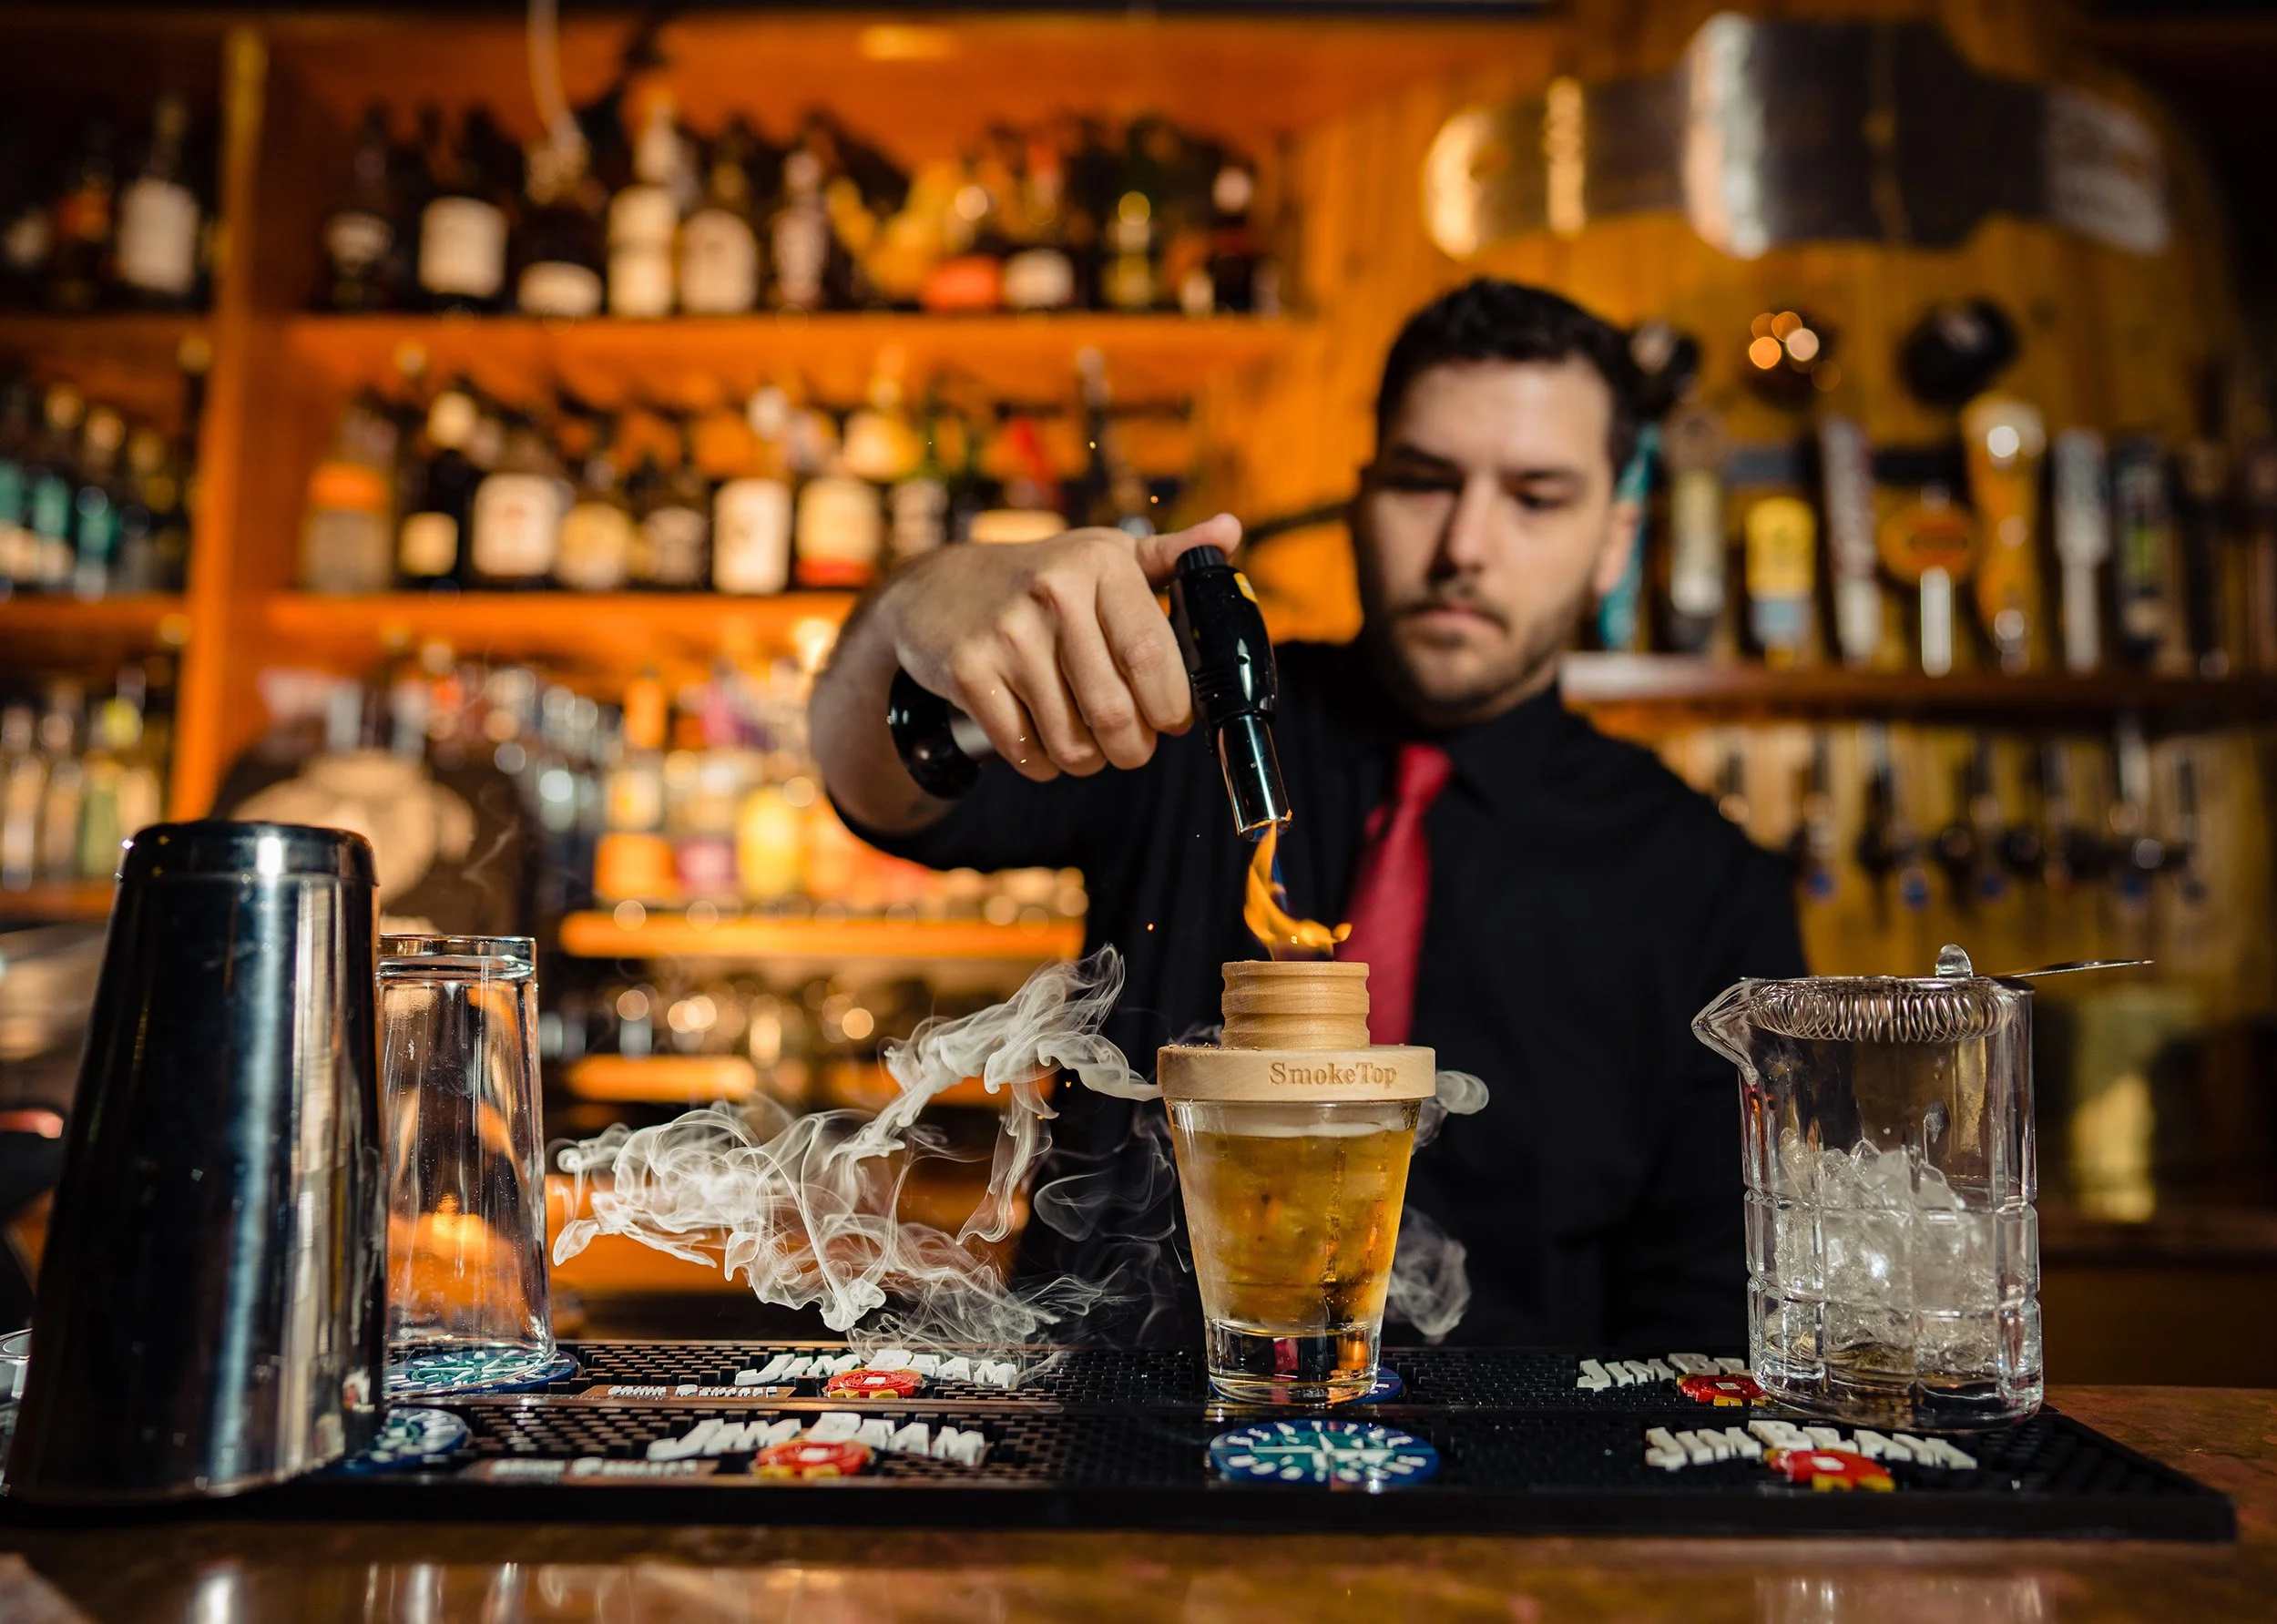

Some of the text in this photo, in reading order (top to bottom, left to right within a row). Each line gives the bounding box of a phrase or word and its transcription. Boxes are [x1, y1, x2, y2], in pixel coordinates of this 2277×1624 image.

[1270, 1061, 1397, 1089] SmokeTop
[735, 1353, 862, 1386] JIM
[1577, 1358, 1676, 1394] JIM
[646, 1417, 802, 1462] JIM
[1645, 1419, 1978, 1472] JIM BEAM
